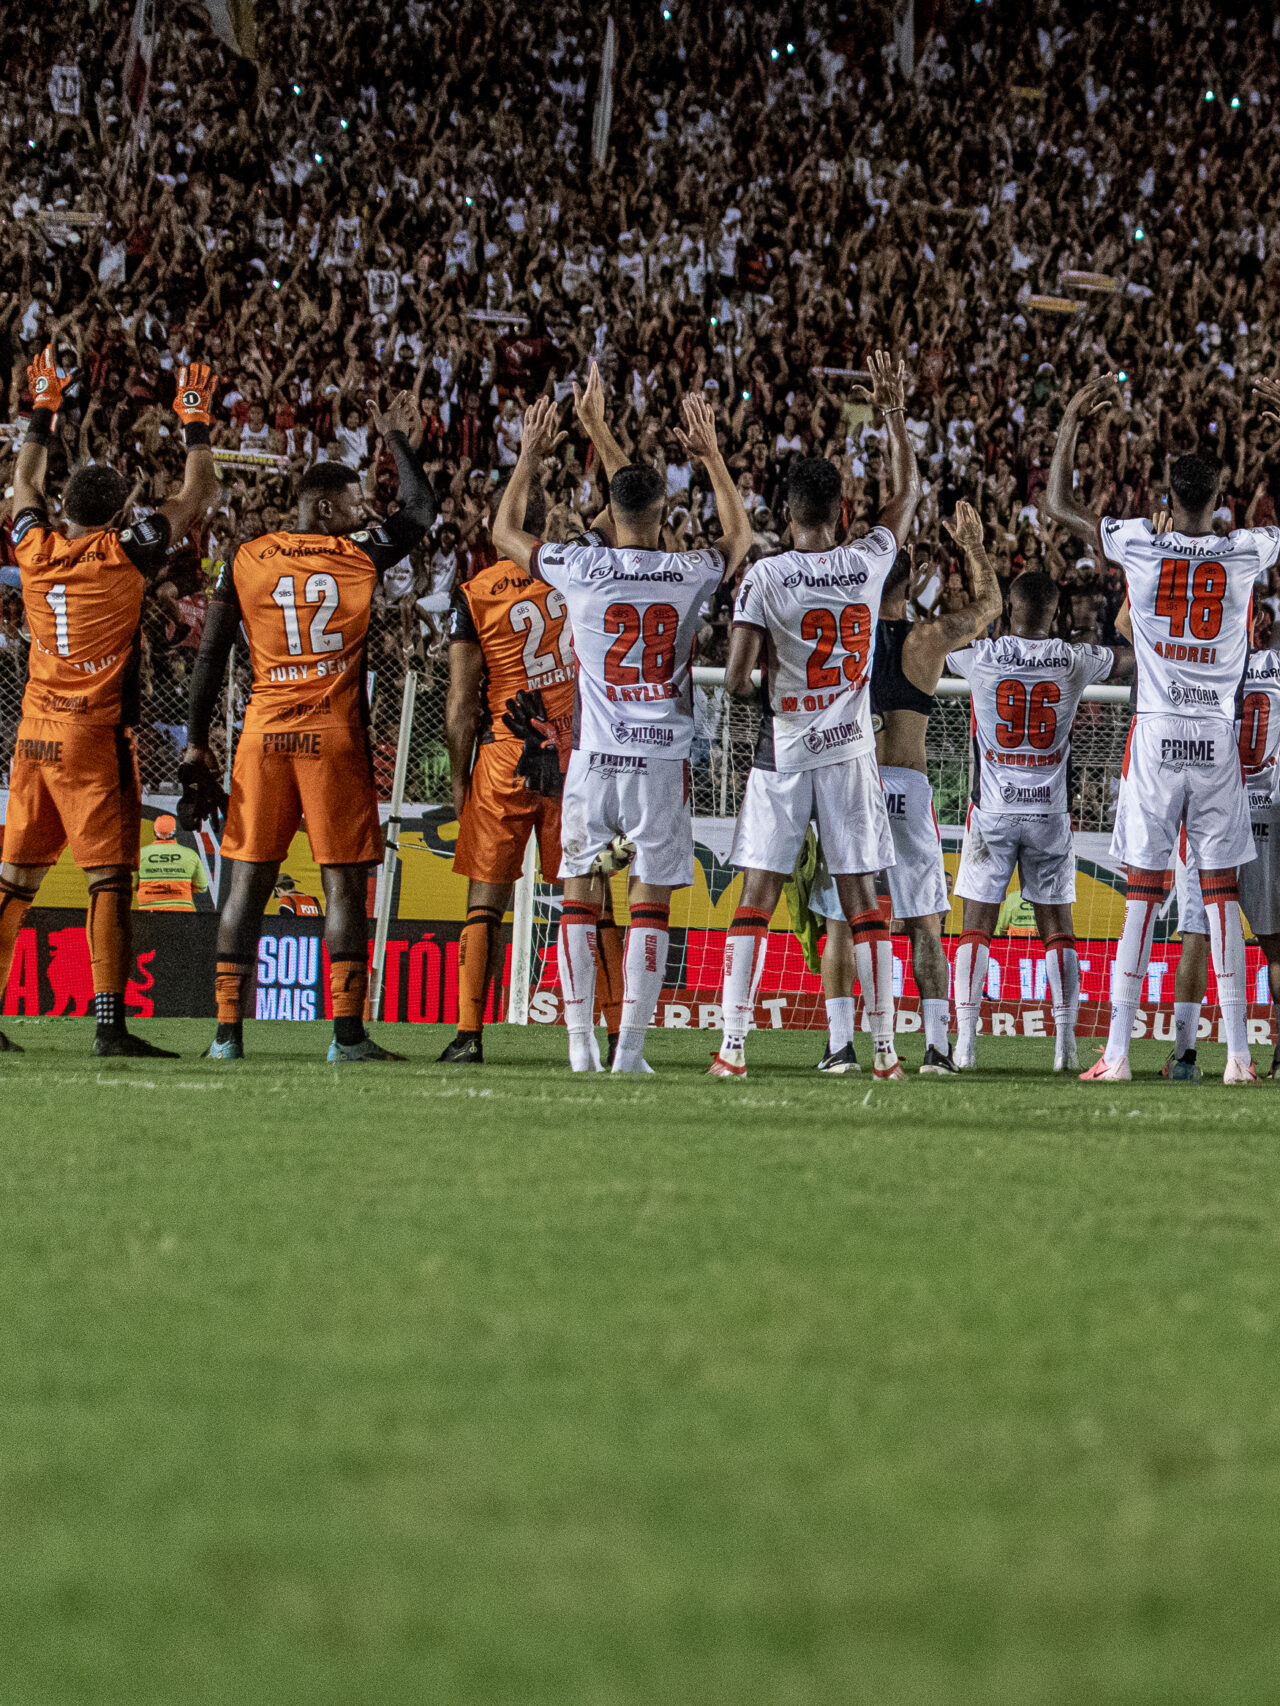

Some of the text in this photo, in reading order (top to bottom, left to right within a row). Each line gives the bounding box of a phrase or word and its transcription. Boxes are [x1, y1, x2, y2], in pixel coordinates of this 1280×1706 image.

[613, 570, 684, 583] UniAGRO
[805, 571, 868, 588] UniAGRO
[1155, 558, 1227, 640] 48
[45, 584, 70, 656] 1
[271, 572, 343, 656] 12
[509, 588, 574, 678] 22
[603, 602, 679, 686] 28
[801, 603, 871, 690] 29
[1154, 641, 1217, 665] ANDREI
[1016, 656, 1069, 668] UniAGRO
[1184, 685, 1218, 701] VITÓRIA
[995, 679, 1061, 749] 96
[262, 733, 321, 754] PRIME
[631, 738, 671, 747] PREMIA
[632, 725, 674, 741] VITÓRIA
[823, 722, 862, 741] VITÓRIA
[826, 733, 863, 750] PREMIA
[18, 739, 63, 763] PRIME
[1161, 738, 1215, 761] PRIME
[148, 853, 182, 863] CSP
[257, 934, 319, 986] SOU
[644, 934, 658, 973] UniBARTER
[255, 987, 316, 1021] MAIS
